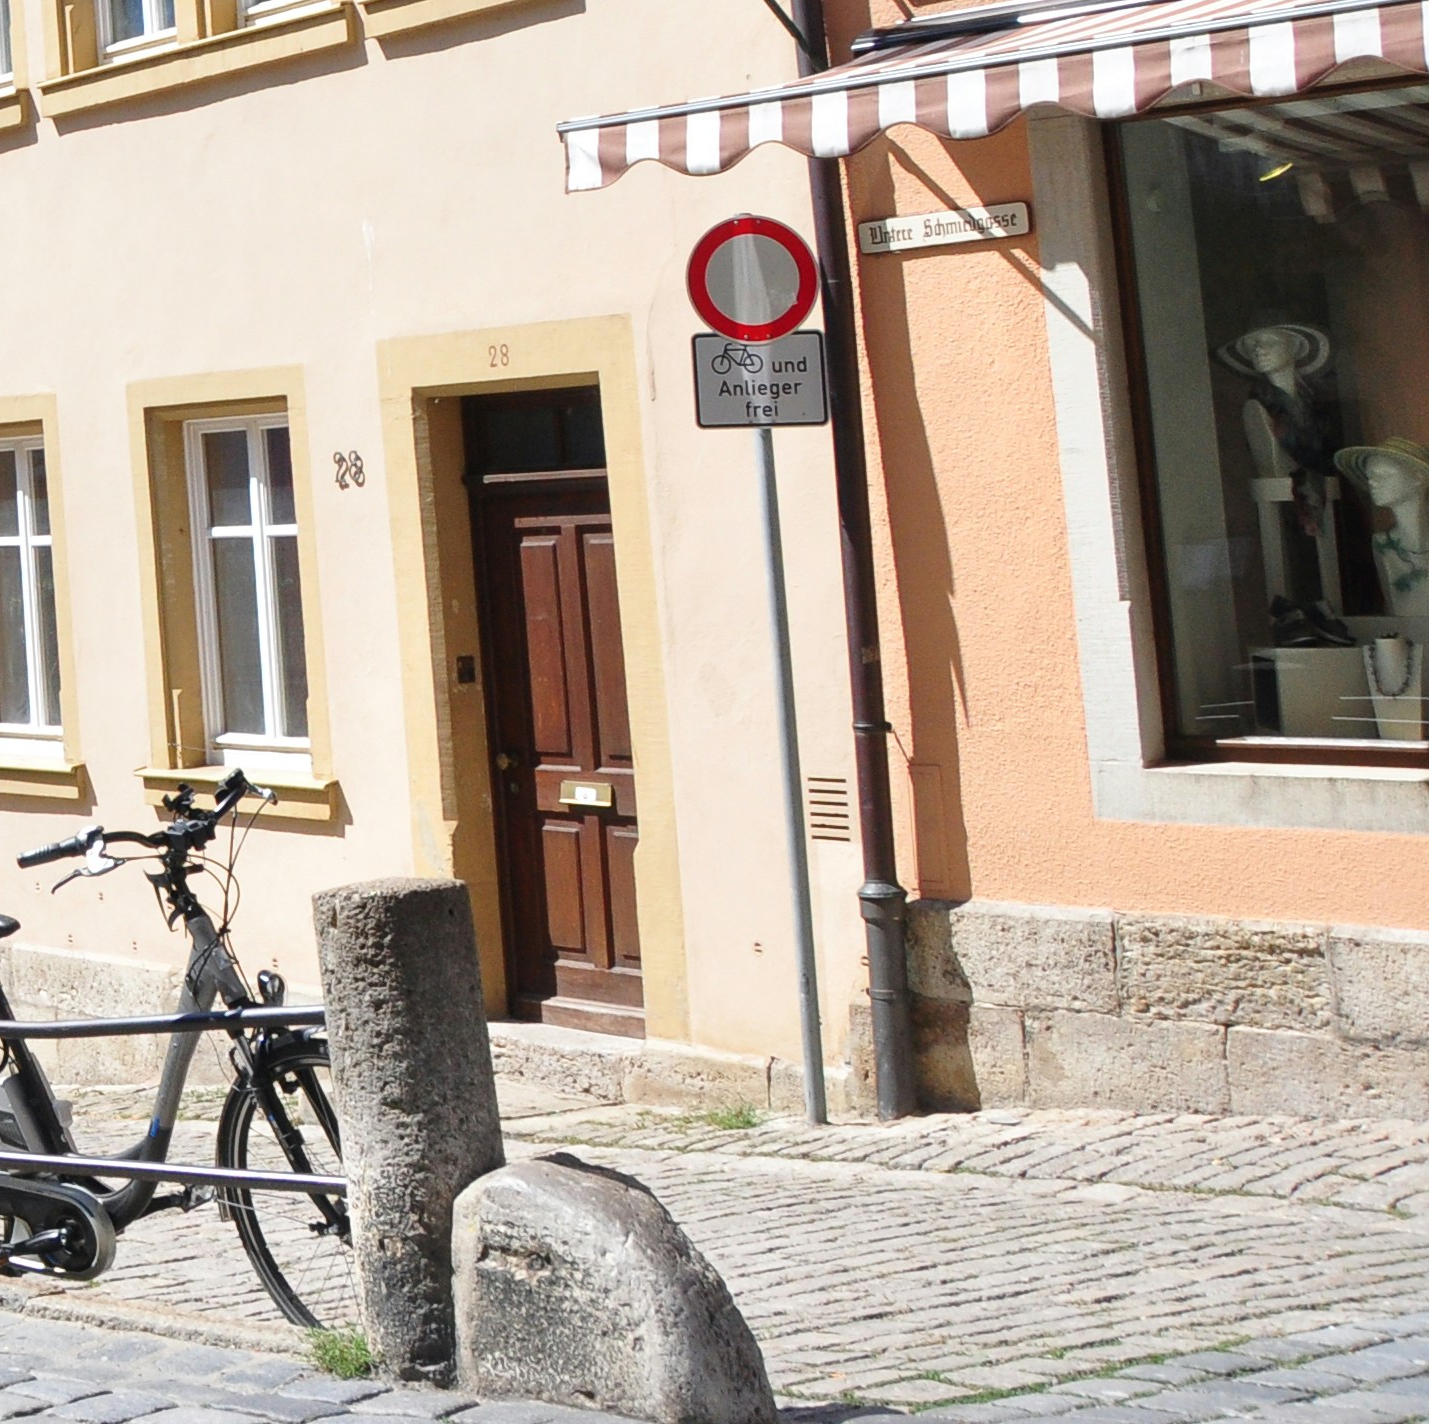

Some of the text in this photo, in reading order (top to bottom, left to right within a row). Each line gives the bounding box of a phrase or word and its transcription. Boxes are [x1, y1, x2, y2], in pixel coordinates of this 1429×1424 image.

[869, 212, 1018, 246] Untere Schmiedgasse
[488, 343, 510, 368] 28
[771, 356, 808, 373] und
[718, 379, 803, 401] Anlieger
[744, 400, 779, 419] frei
[333, 450, 366, 491] 28
